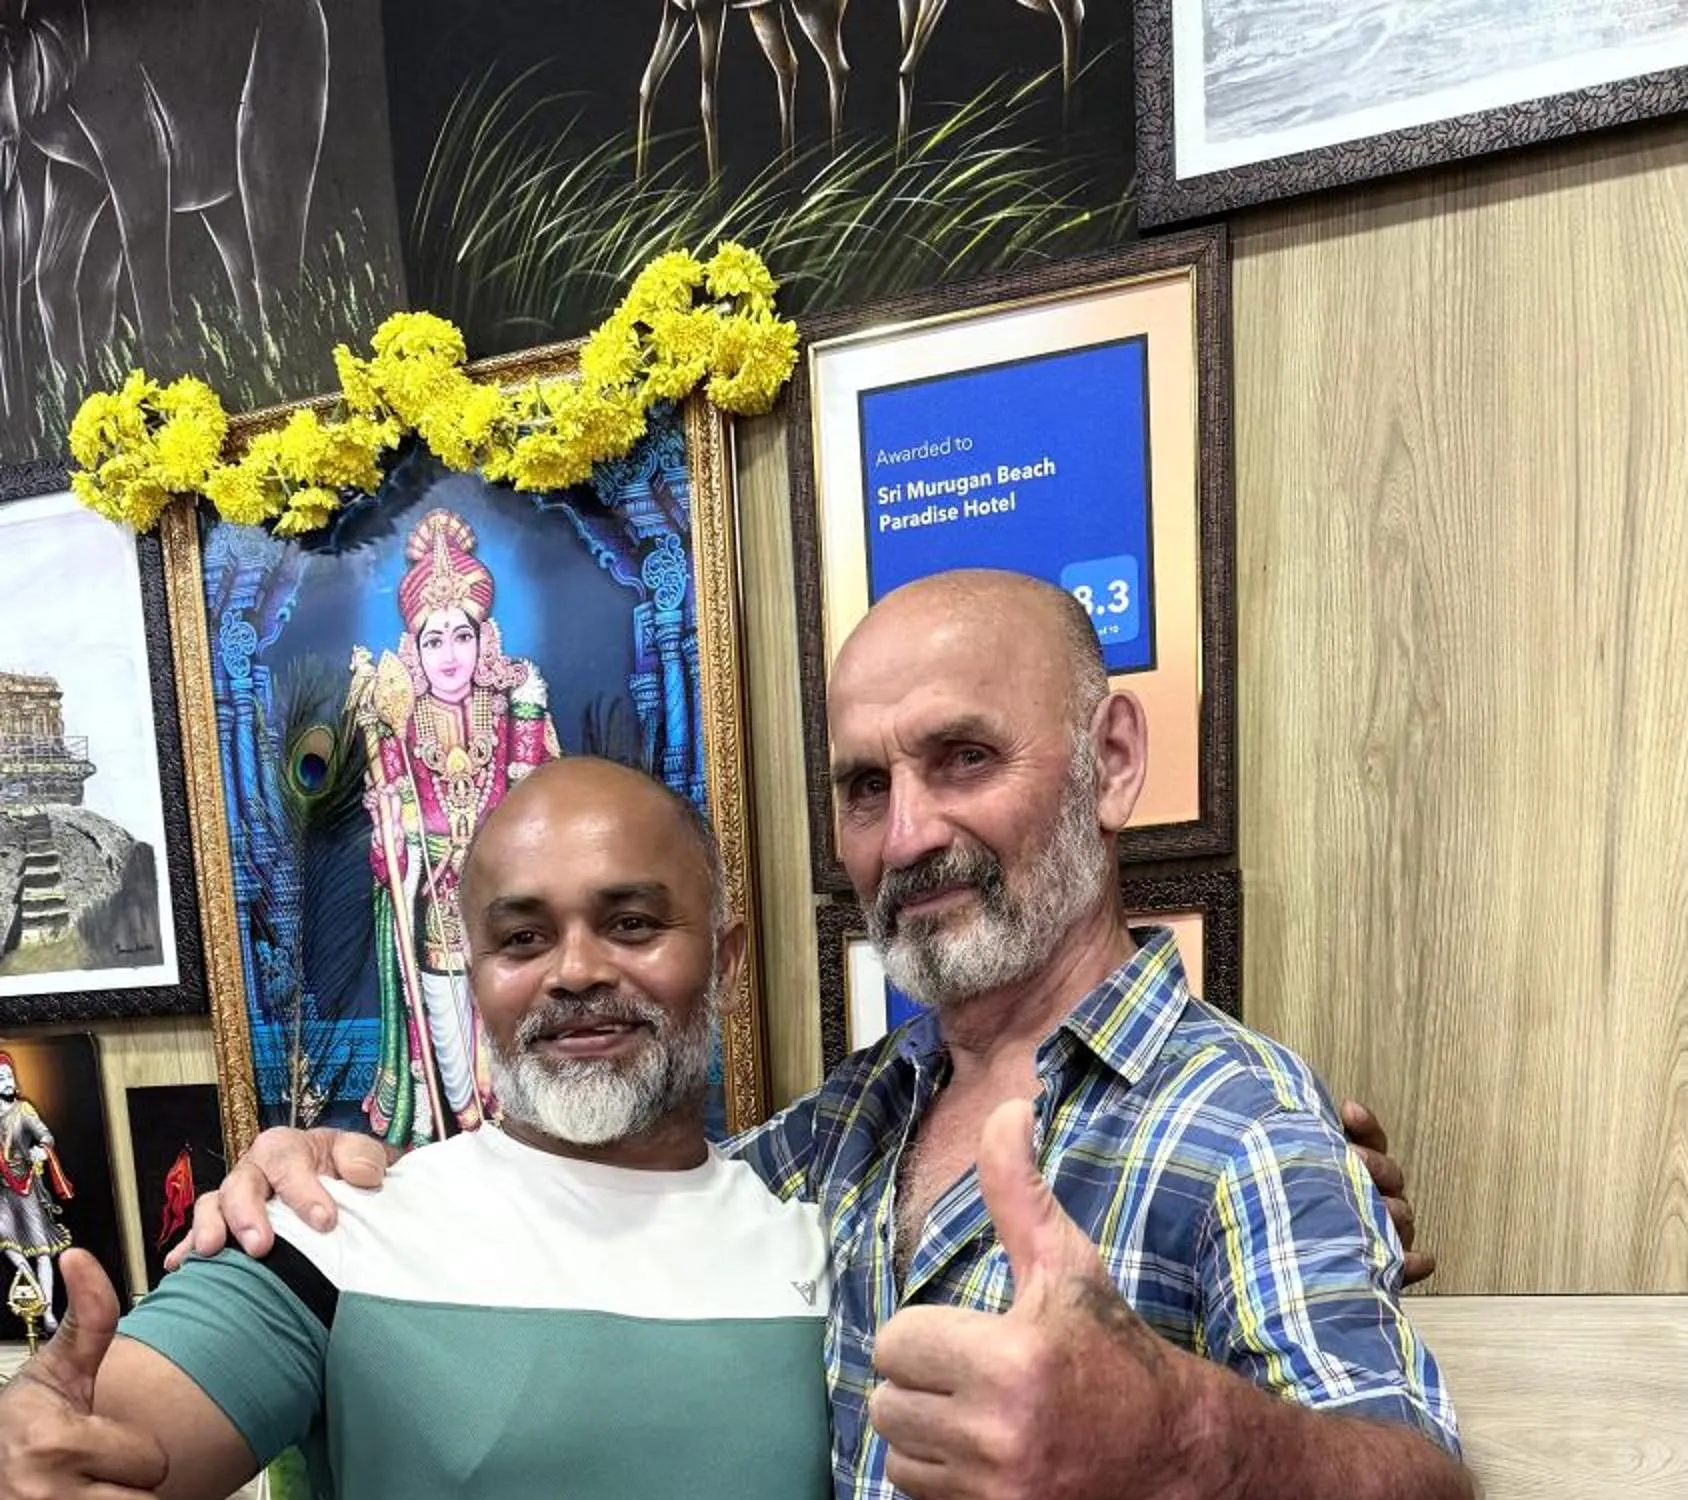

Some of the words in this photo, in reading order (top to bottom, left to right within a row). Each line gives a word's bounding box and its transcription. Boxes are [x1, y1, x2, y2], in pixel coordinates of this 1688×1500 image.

[876, 436, 950, 467] Awarded
[955, 437, 973, 451] to
[877, 483, 901, 505] Sri
[907, 471, 992, 500] Murugan
[997, 457, 1056, 485] Beach
[879, 505, 958, 533] Paradise
[963, 491, 1016, 518] Hotel
